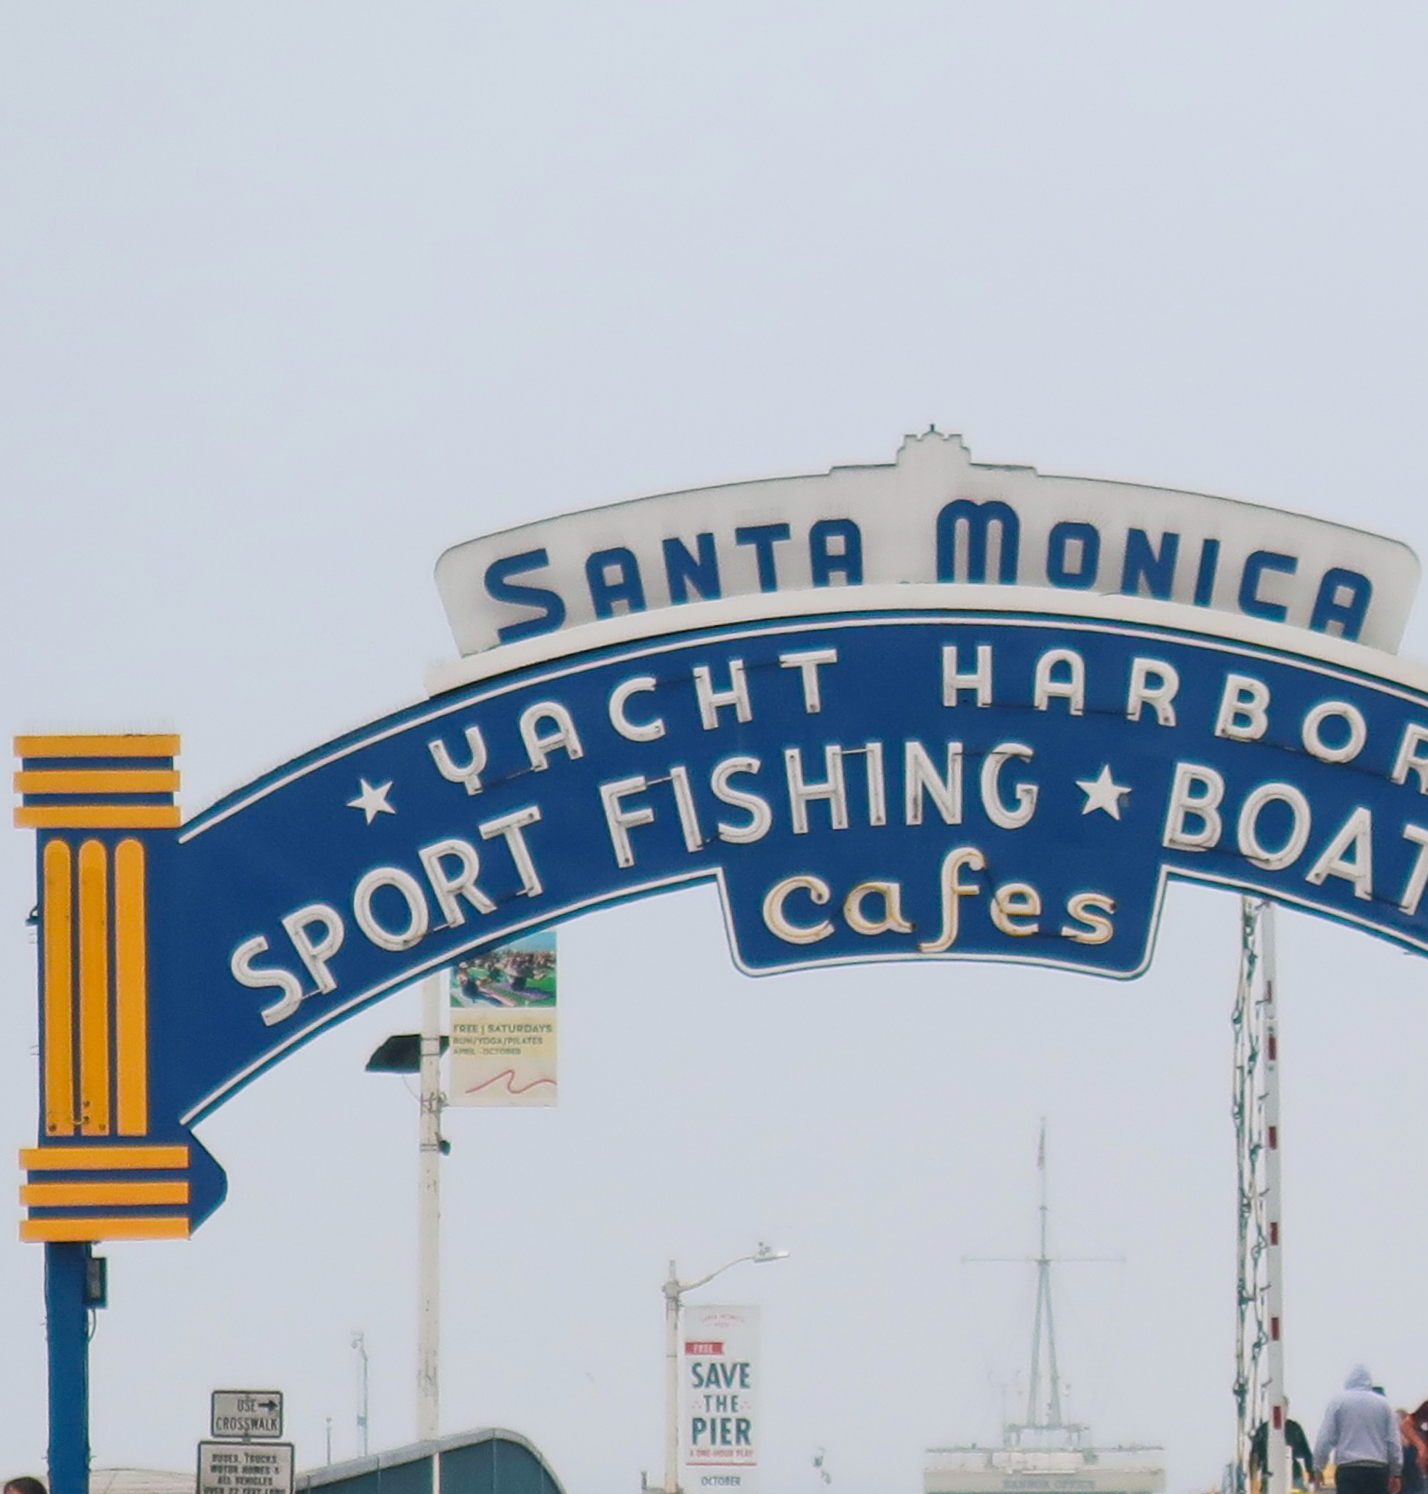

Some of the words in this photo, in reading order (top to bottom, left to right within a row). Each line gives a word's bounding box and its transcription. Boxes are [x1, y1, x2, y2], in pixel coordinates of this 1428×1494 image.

[484, 518, 863, 643] SANTA
[935, 498, 1374, 642] MONICA
[428, 649, 838, 796] YACHT
[231, 806, 543, 1027] SPORT
[600, 741, 1038, 869] FISHING
[487, 1024, 553, 1033] SATURDAYS
[691, 1361, 751, 1390] SAVE
[237, 1399, 257, 1412] USE
[703, 1395, 739, 1413] THE
[216, 1416, 279, 1431] CROSSWALK
[691, 1417, 753, 1446] PIER
[701, 1476, 741, 1487] OCTOBER
